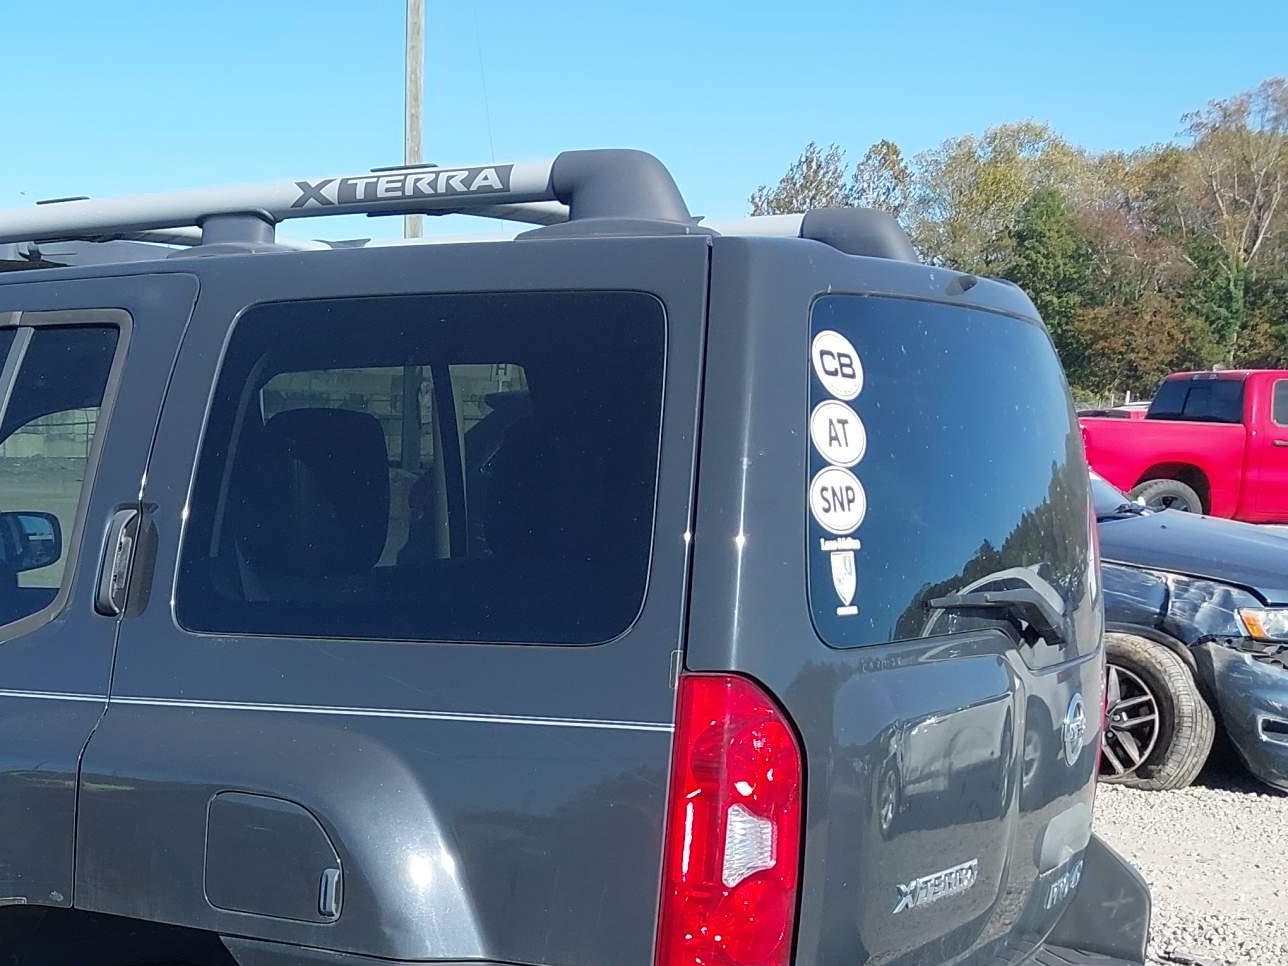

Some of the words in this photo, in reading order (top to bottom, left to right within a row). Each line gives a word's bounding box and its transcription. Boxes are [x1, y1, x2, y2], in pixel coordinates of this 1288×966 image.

[819, 349, 857, 379] CB
[828, 418, 849, 448] AT
[820, 485, 856, 513] SNP
